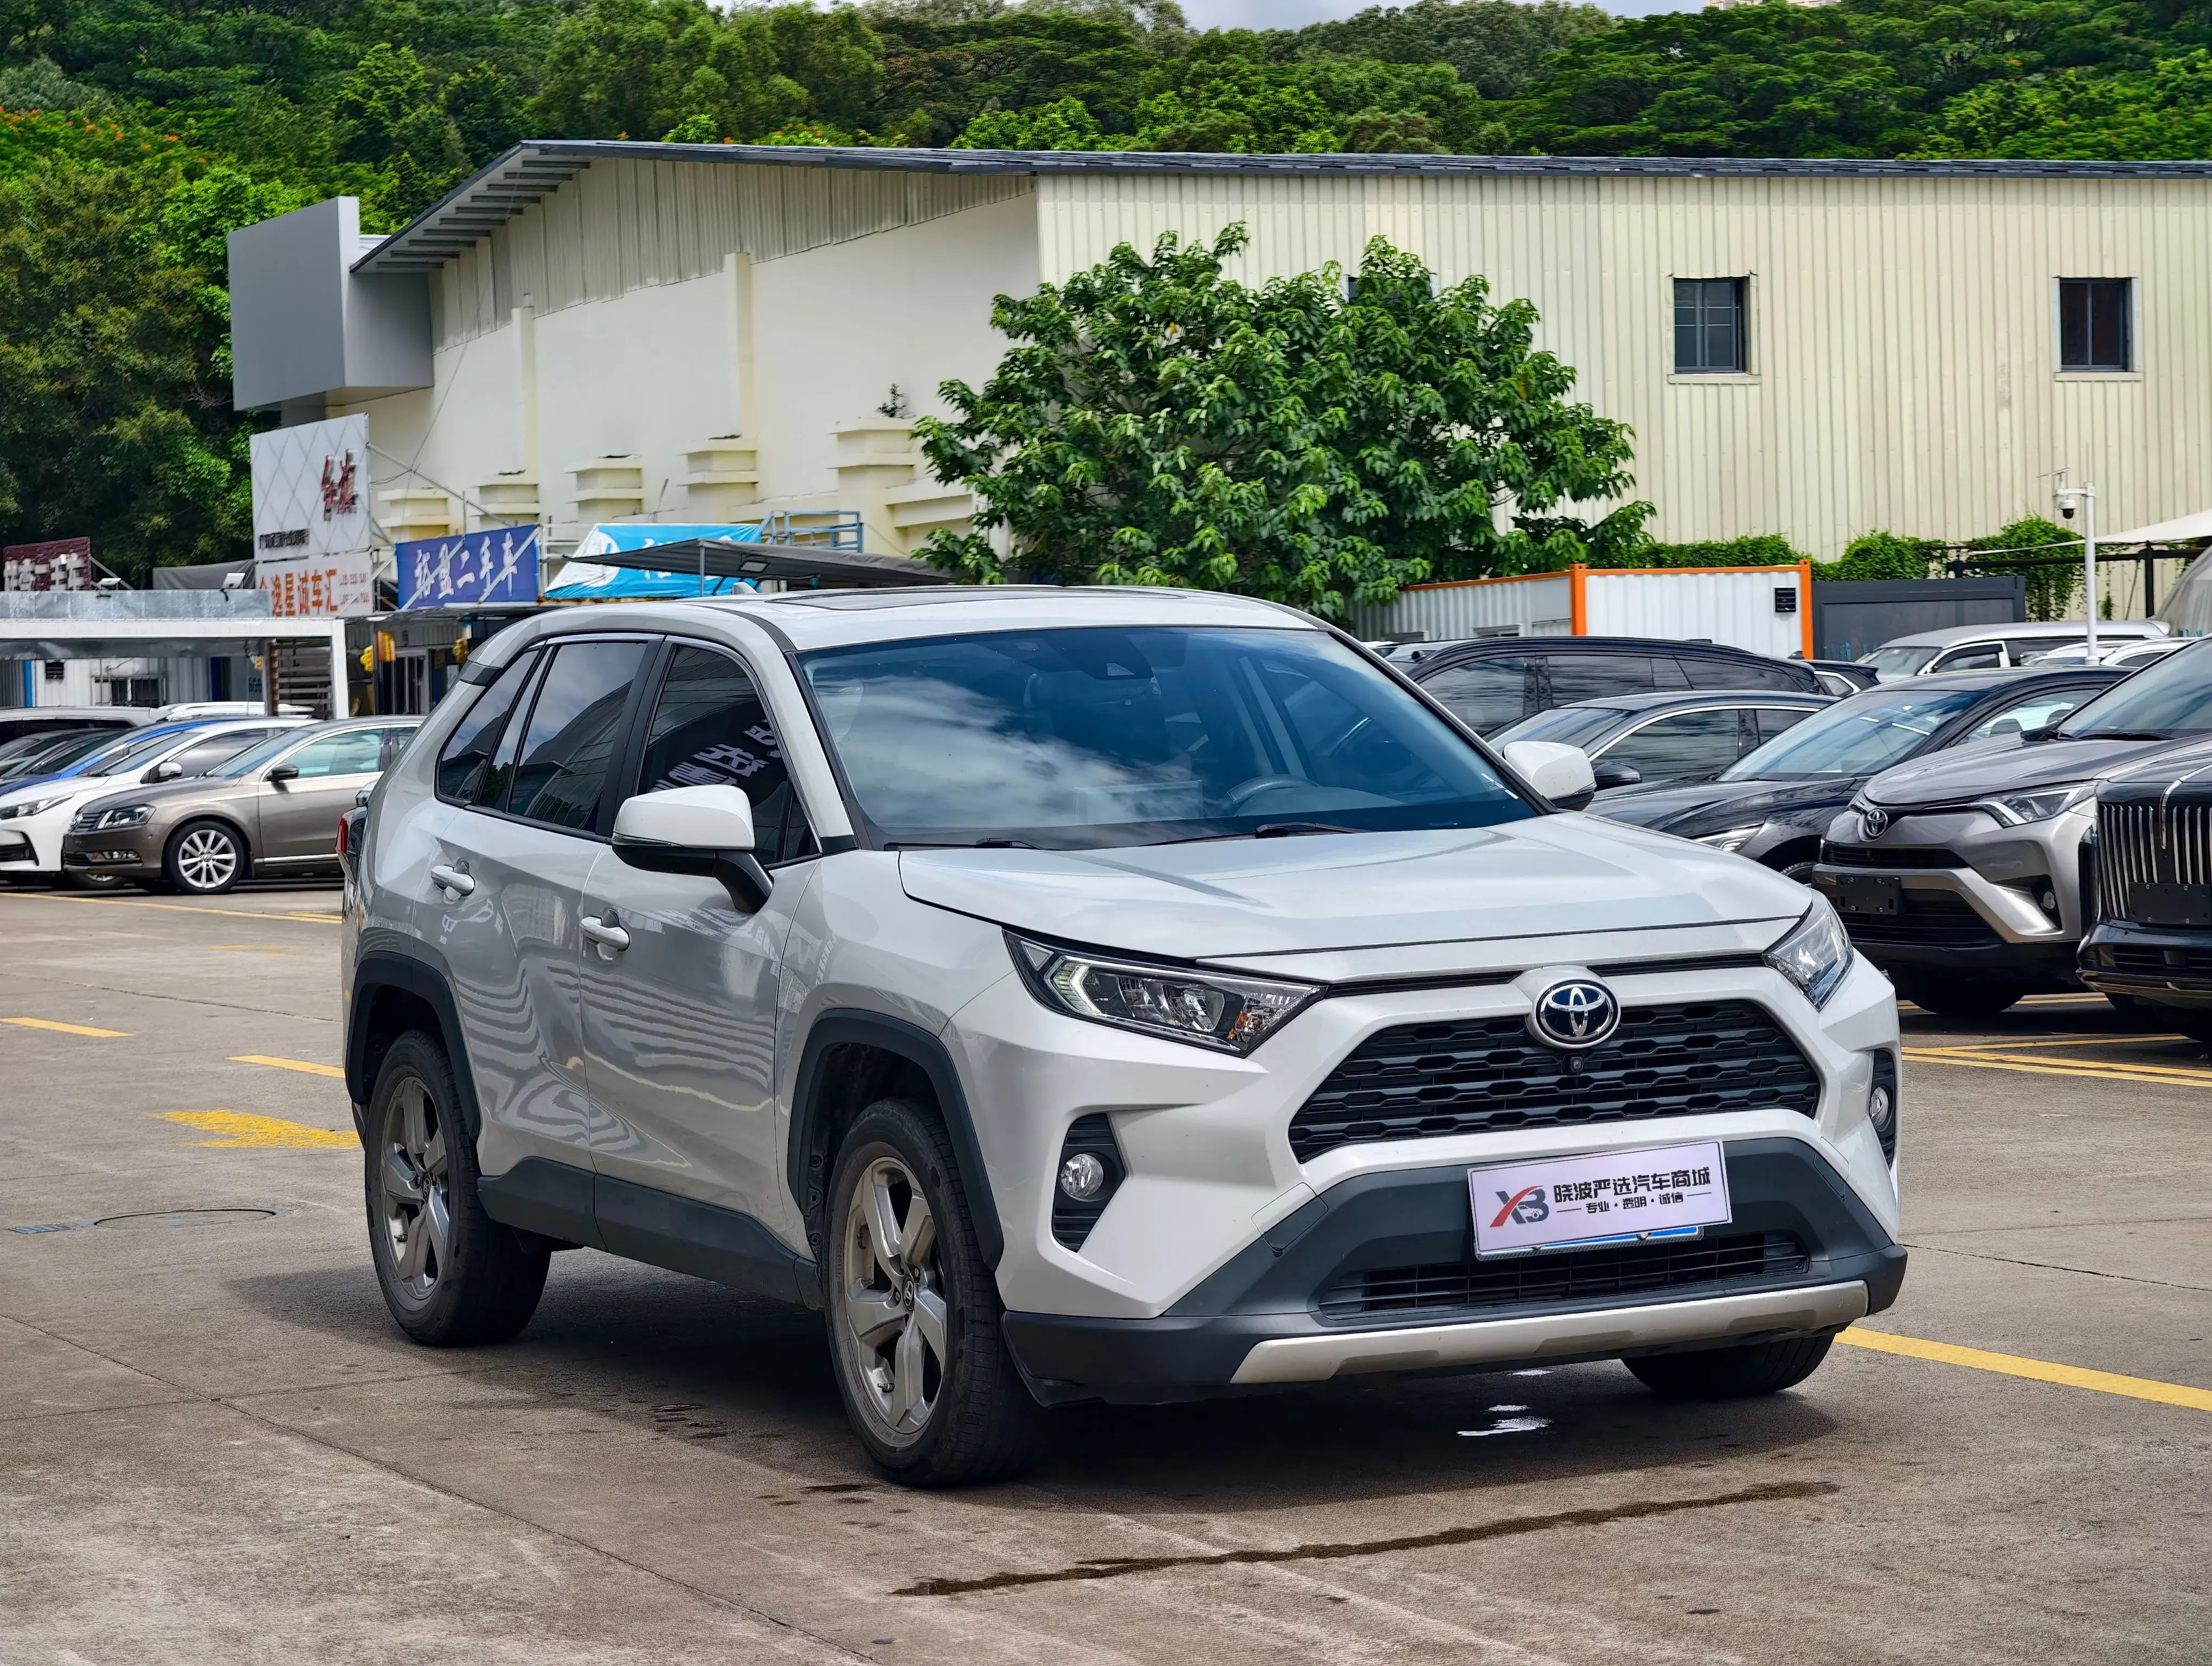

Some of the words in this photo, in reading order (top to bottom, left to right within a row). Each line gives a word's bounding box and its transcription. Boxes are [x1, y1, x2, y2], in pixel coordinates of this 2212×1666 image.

[1553, 1167, 1711, 1203] 晓波严选汽车商城
